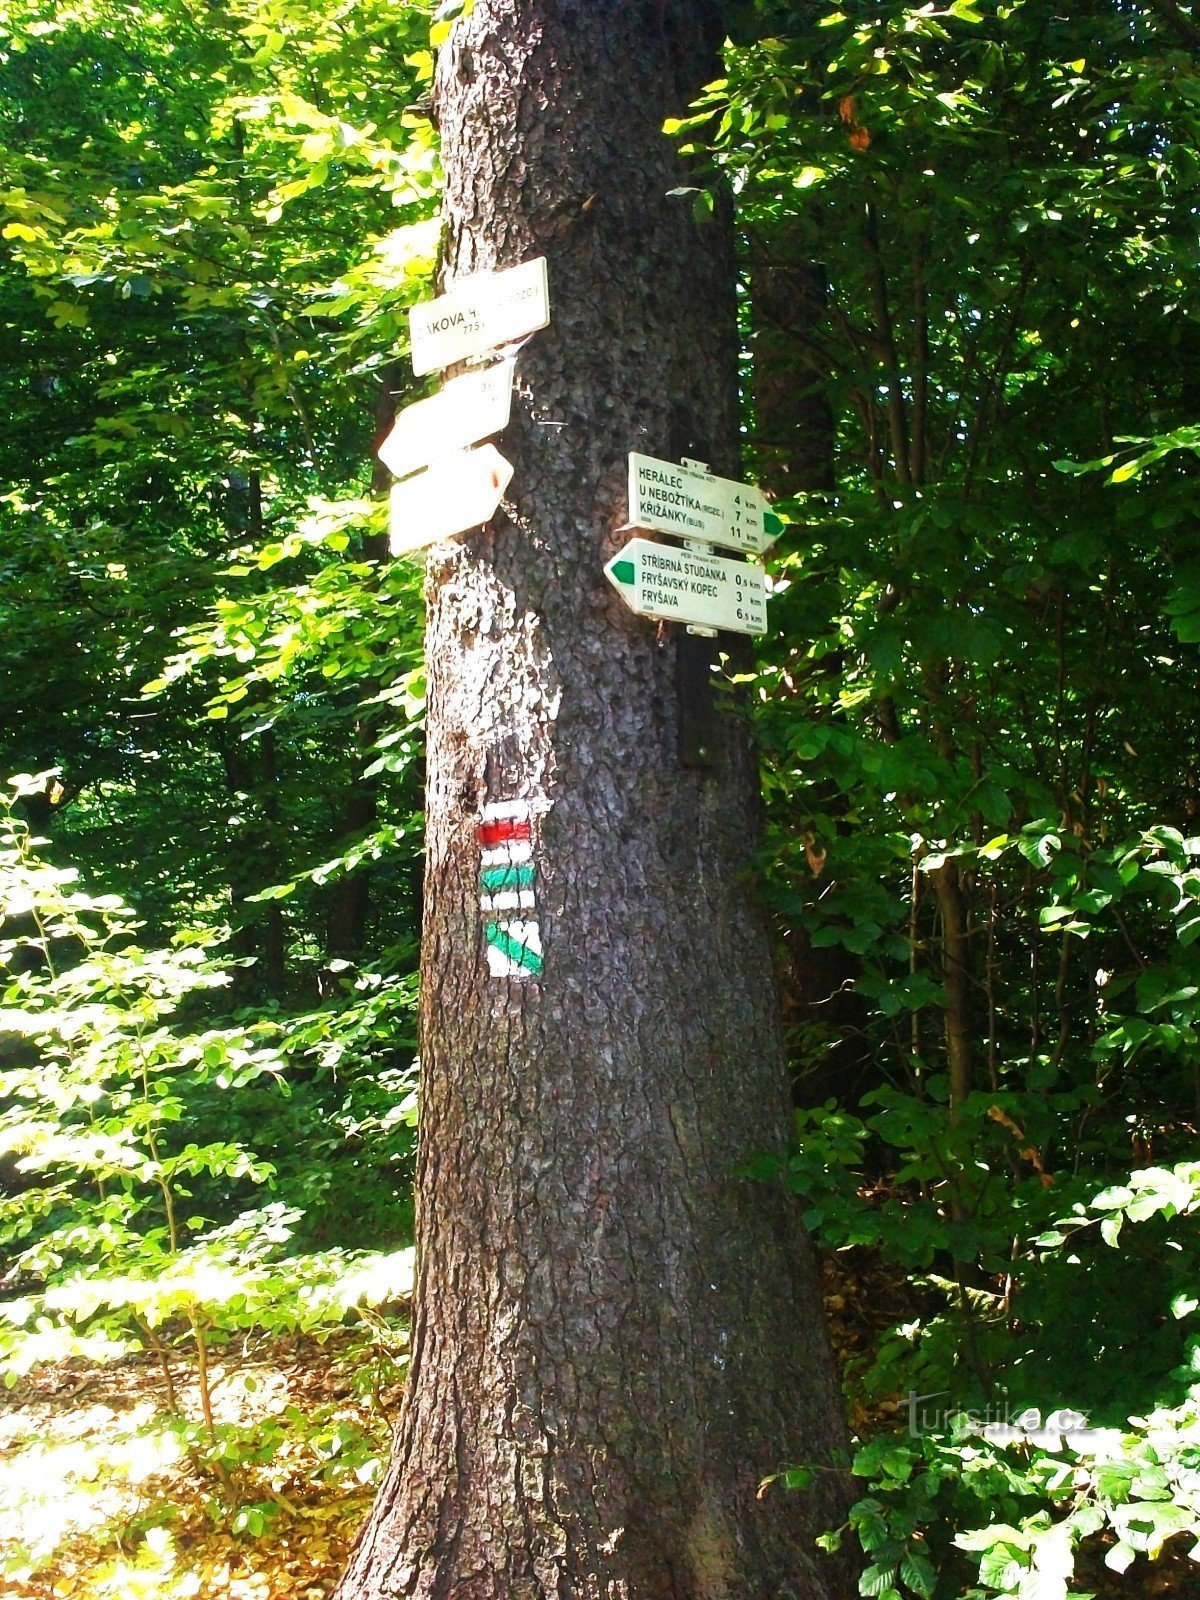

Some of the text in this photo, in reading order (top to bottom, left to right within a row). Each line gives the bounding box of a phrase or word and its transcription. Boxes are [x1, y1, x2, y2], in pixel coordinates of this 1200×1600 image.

[639, 467, 682, 489] HERÁLEC
[734, 495, 741, 506] 4
[745, 501, 757, 510] km
[639, 484, 646, 496] U
[648, 487, 702, 511] NEBOŽTÍKA
[735, 511, 741, 521] 7
[746, 517, 758, 527] km
[731, 526, 741, 538] 11
[747, 533, 758, 543] km
[641, 554, 682, 574] STŘÍBRNÁ
[684, 563, 727, 583] STUDÁNKA
[749, 580, 761, 590] km
[641, 571, 762, 607] FRYŠAVSKÝ KOPEC 3 km
[642, 590, 679, 607] FRYŠAVA
[751, 614, 763, 624] km
